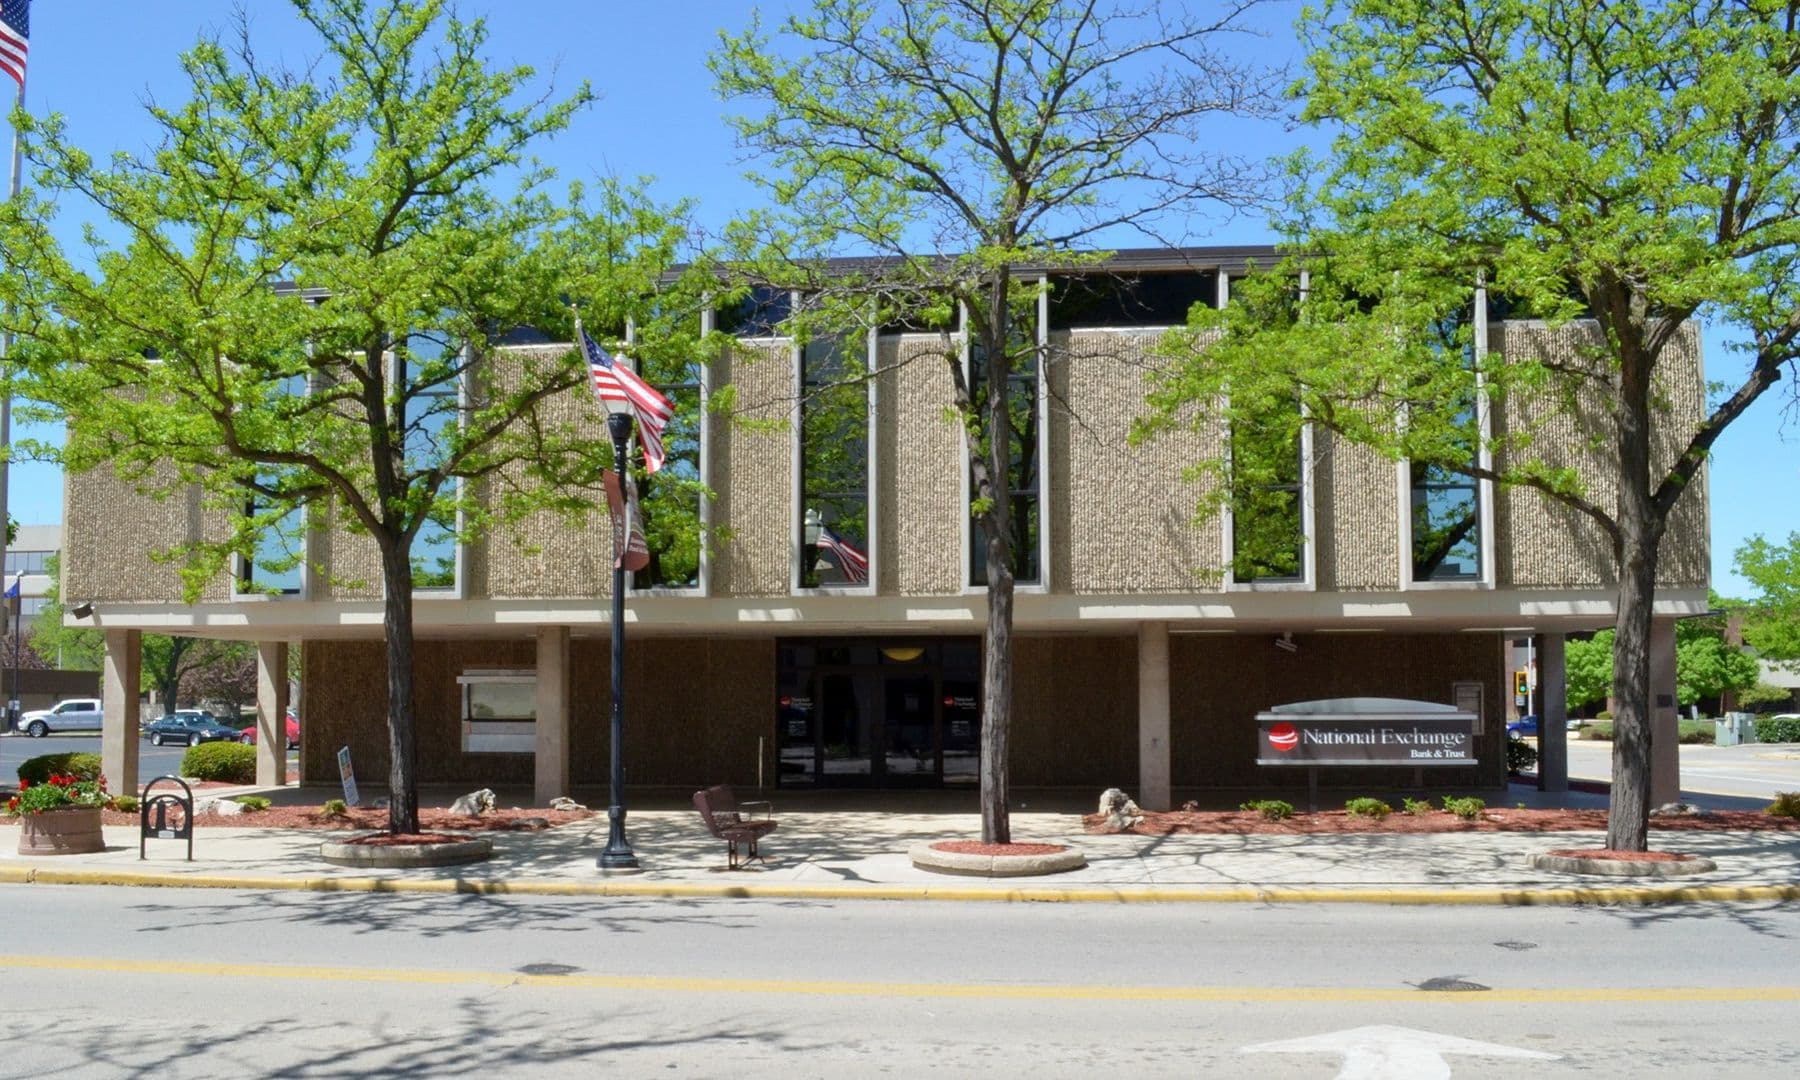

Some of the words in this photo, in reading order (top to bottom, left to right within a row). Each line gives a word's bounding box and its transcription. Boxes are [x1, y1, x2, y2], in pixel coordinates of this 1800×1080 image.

[1303, 728, 1376, 744] National
[1380, 727, 1465, 748] Exchange
[1410, 749, 1433, 758] Bank
[1433, 749, 1443, 758] &
[1443, 749, 1465, 758] Trust
